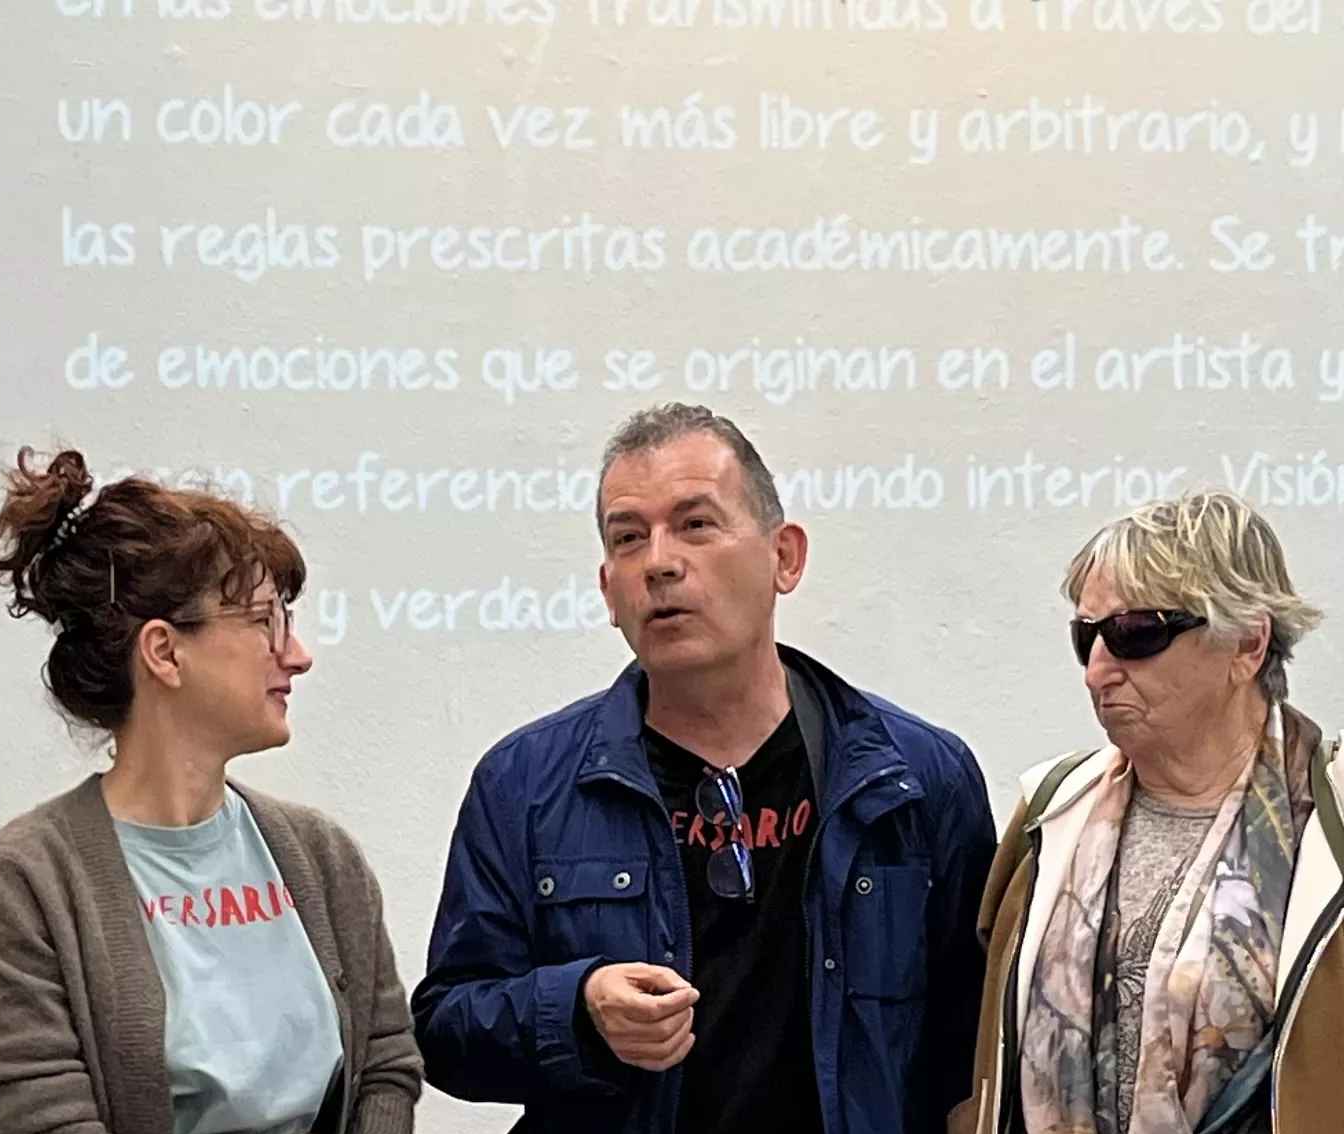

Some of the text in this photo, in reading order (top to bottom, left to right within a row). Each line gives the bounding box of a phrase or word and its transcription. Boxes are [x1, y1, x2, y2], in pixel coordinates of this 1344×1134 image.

[969, 0, 1006, 32] a
[1246, 0, 1322, 35] del
[57, 97, 133, 144] un
[156, 83, 303, 146] color
[325, 90, 465, 150] cada
[487, 103, 596, 150] vez
[618, 90, 739, 150] más
[759, 92, 885, 151] libre
[908, 109, 941, 165] y
[957, 94, 1265, 161] arbitrario,
[1289, 112, 1319, 166] y
[61, 206, 137, 267] las
[160, 206, 339, 281] reglas
[362, 214, 667, 281] prescritas
[686, 213, 1185, 274] académicamente.
[1209, 214, 1275, 273] Se
[64, 331, 135, 390] de
[157, 335, 460, 391] emociones
[481, 344, 581, 405] que
[602, 347, 662, 393] se
[683, 335, 917, 404] originan
[936, 346, 1011, 392] en
[1027, 331, 1075, 391] el
[1094, 331, 1296, 393] artista
[276, 451, 596, 511] referencia
[774, 453, 945, 511] mundo
[316, 575, 609, 646] y verdade
